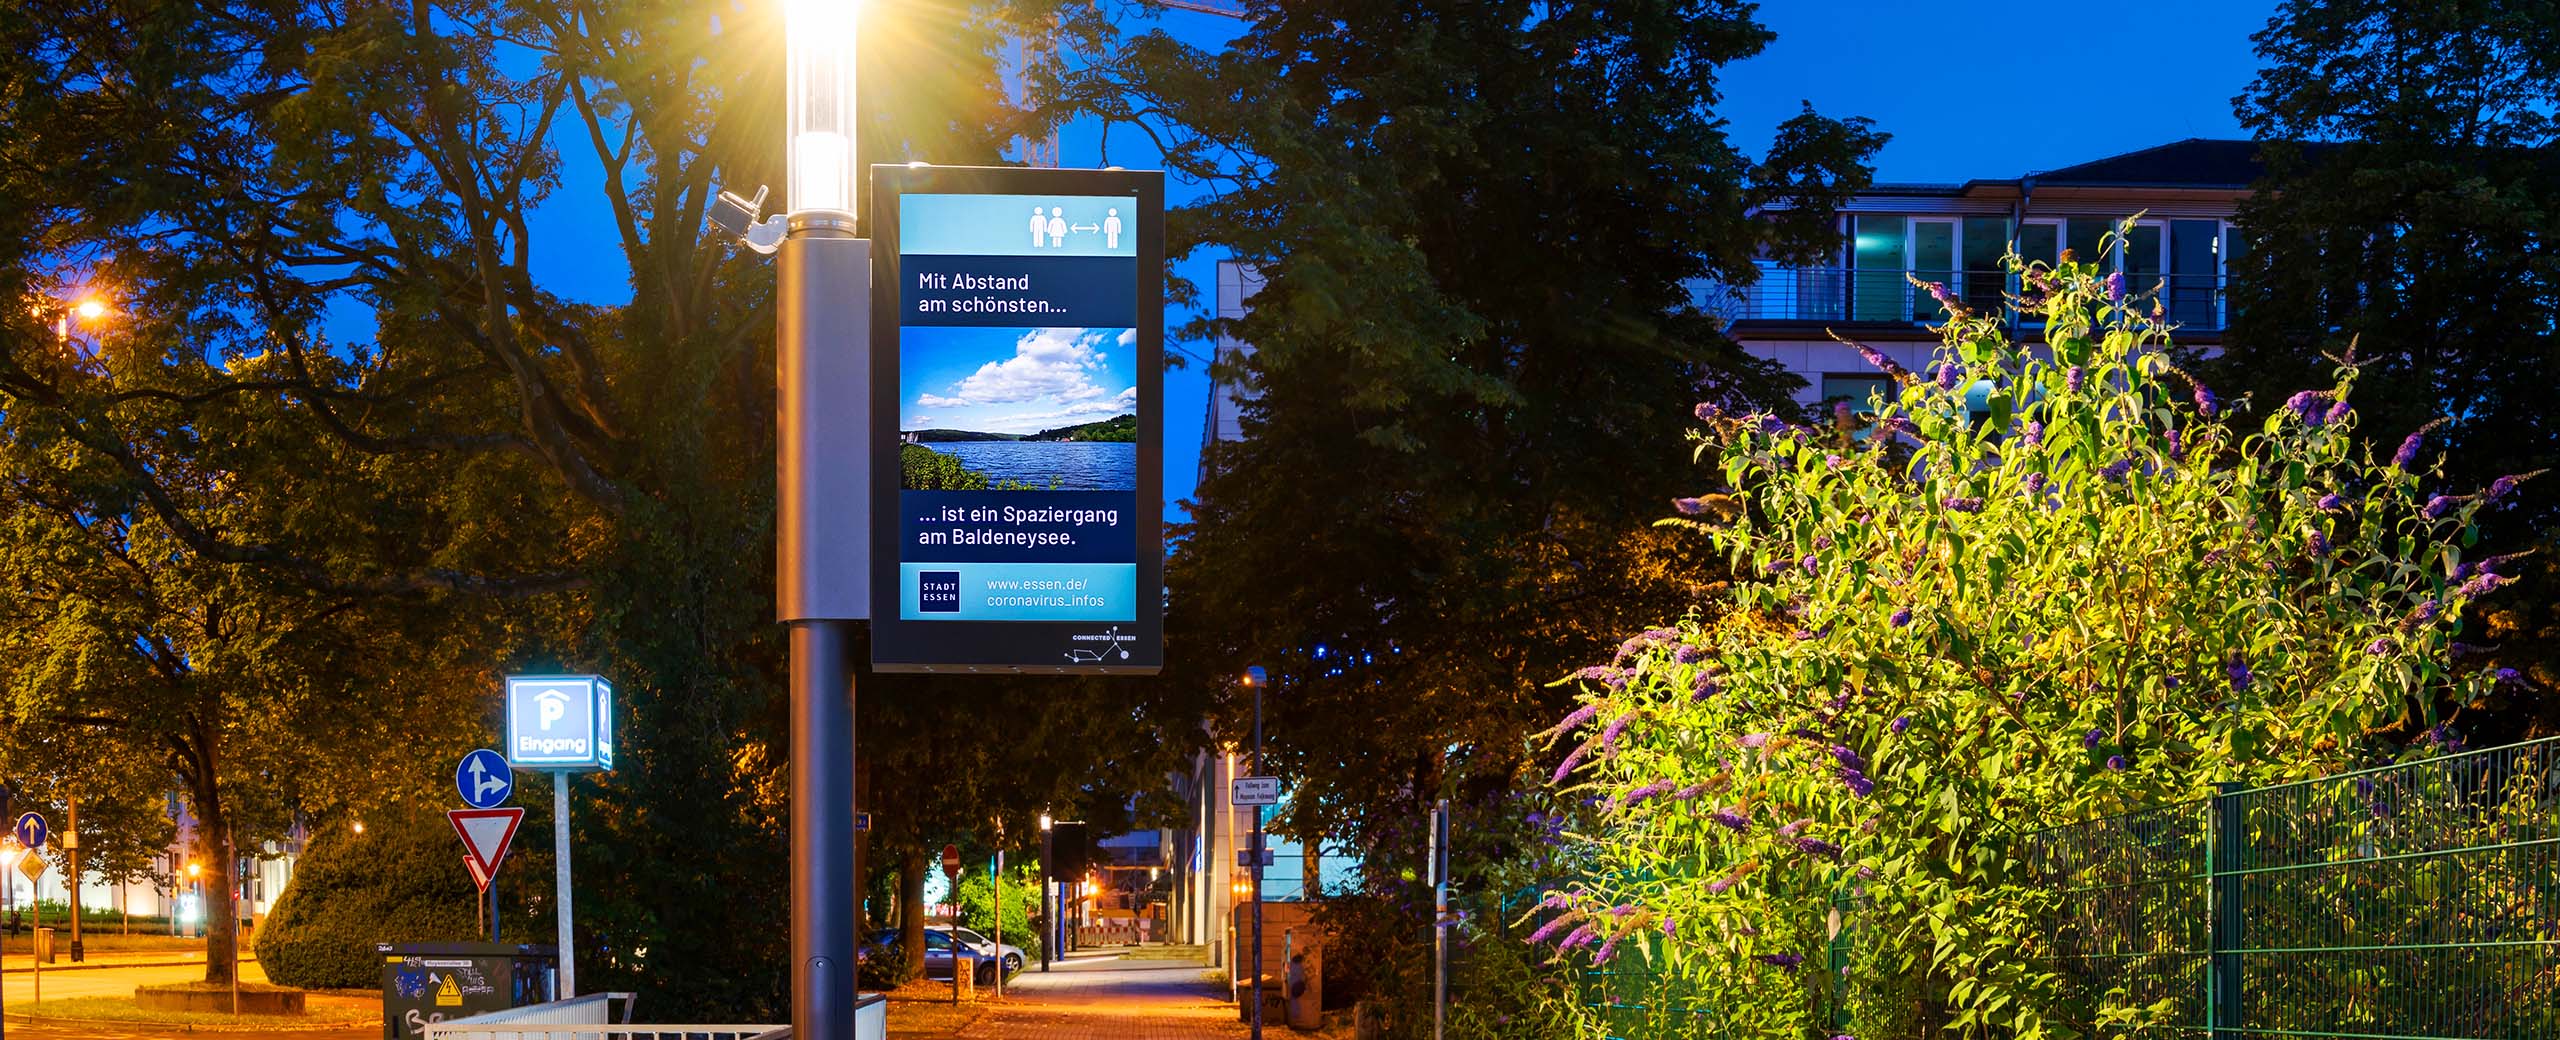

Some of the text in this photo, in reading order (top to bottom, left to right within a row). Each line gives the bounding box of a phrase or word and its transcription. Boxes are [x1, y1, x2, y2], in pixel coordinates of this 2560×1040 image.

[918, 272, 1029, 290] Mit Abstand
[918, 296, 1067, 313] am schönsten...
[942, 505, 965, 522] ist
[970, 505, 998, 522] ein
[1003, 505, 1118, 527] Spaziergang
[919, 528, 1076, 549] am Baldeneysee.
[923, 582, 956, 591] STADT
[987, 578, 1088, 590] www.essen.de/
[923, 593, 956, 601] ESSEN
[987, 594, 1105, 607] coronavirus_infos
[519, 736, 587, 754] Eingang
